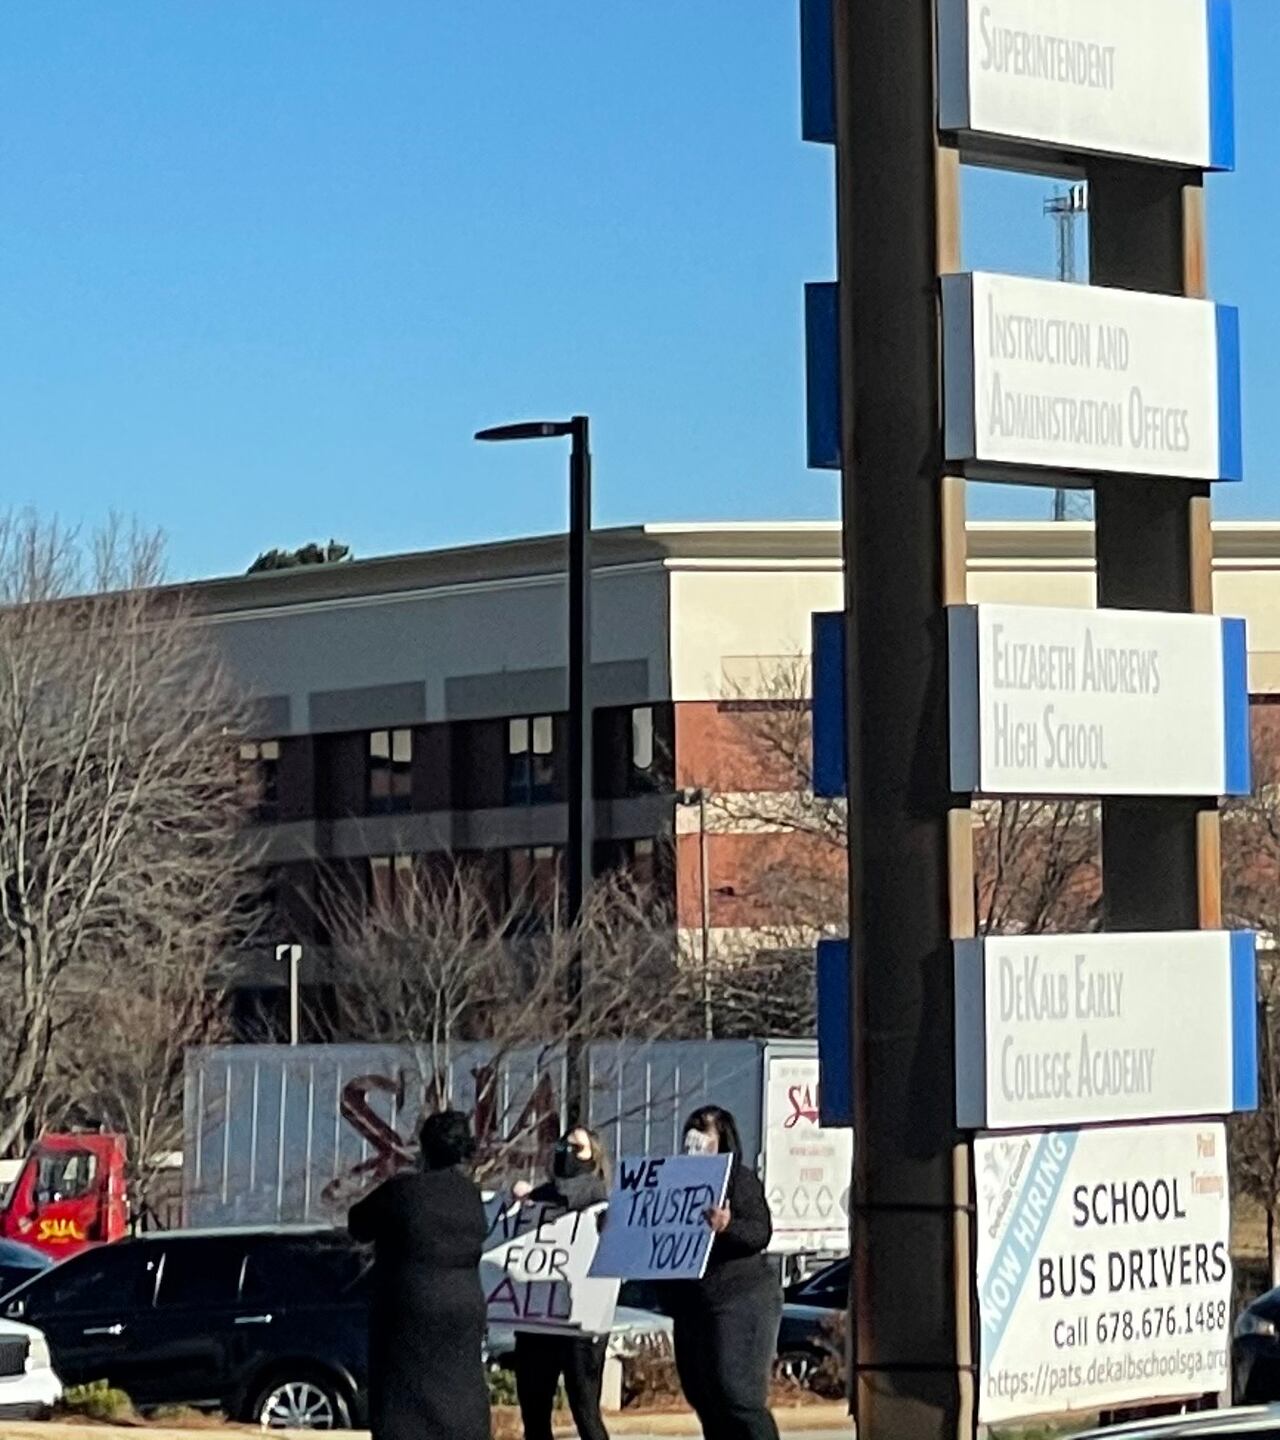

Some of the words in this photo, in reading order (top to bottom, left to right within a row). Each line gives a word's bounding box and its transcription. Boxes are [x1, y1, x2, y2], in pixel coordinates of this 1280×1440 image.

[979, 6, 1115, 90] SUPERINTENDENT
[988, 293, 1090, 368] INSTRUCTION
[1097, 325, 1129, 372] AND
[989, 372, 1122, 447] ADMINISTRATION
[1128, 386, 1189, 452] OFFICES
[992, 623, 1076, 692] ELIZABETH
[1082, 627, 1161, 694] ANDREWS
[994, 702, 1037, 769] HIGH
[1043, 704, 1107, 770] SCHOOL
[1075, 954, 1123, 1018] EARLY
[1002, 1035, 1072, 1101] COLLEGE
[1077, 1032, 1155, 1098] ACADEMY
[620, 1159, 666, 1191] WE
[628, 1183, 716, 1229] TRUSTED
[1073, 1178, 1186, 1227] SCHOOL
[650, 1230, 703, 1270] YOU!
[982, 1249, 1021, 1332] NOW
[1013, 1132, 1068, 1253] HIRING
[503, 1246, 570, 1281] FOR
[1039, 1254, 1096, 1301] BUS
[1108, 1241, 1226, 1293] DRIVERS
[486, 1276, 573, 1320] ALL
[1054, 1317, 1088, 1348] Call
[1096, 1300, 1226, 1343] 678.676.1488
